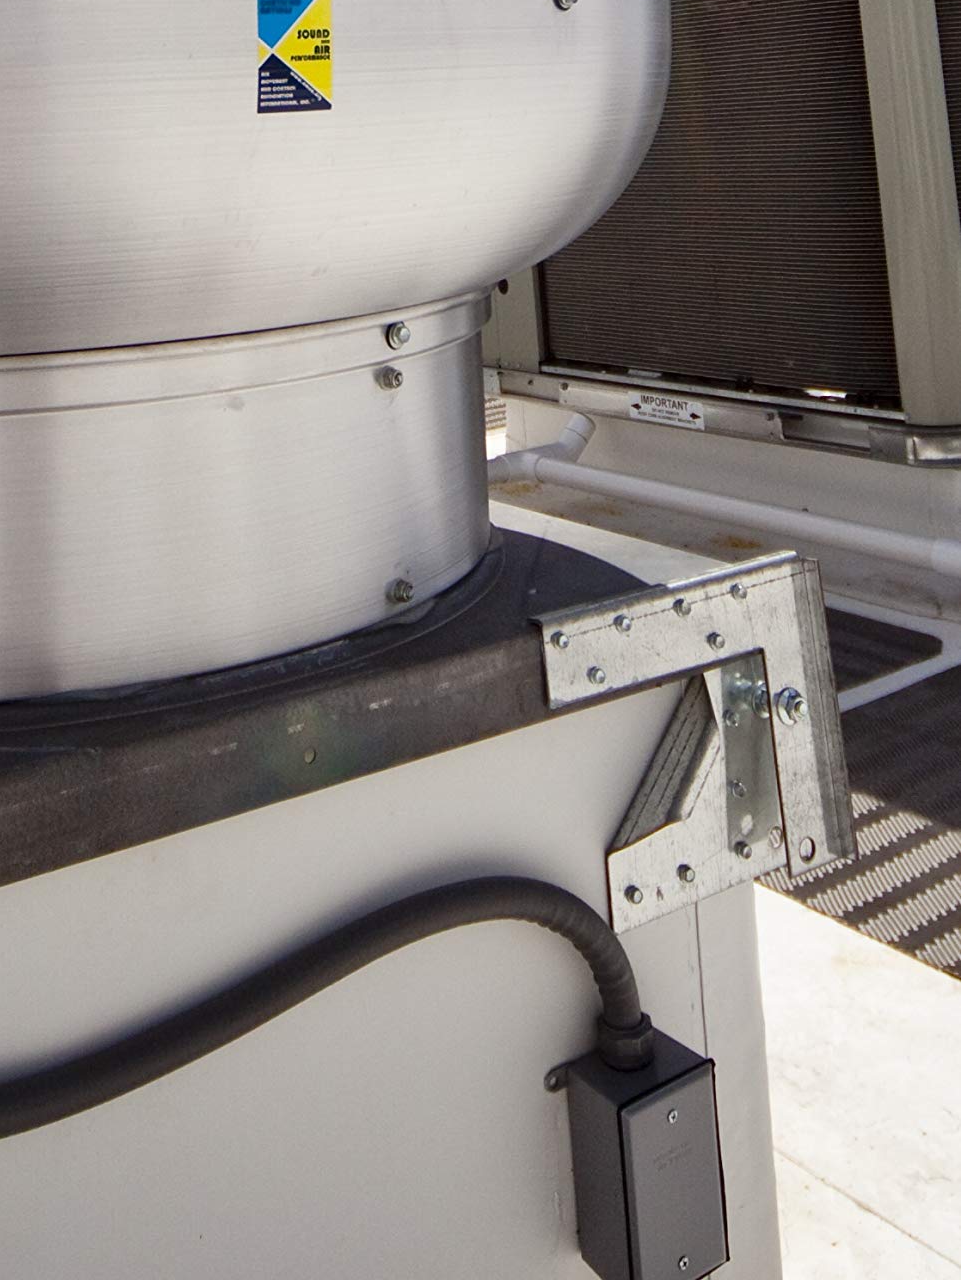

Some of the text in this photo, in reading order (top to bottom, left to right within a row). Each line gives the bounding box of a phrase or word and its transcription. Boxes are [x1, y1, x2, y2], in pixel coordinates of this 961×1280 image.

[297, 29, 330, 39] SOUND
[314, 45, 330, 55] AIR
[640, 394, 689, 411] IMPORTANT
